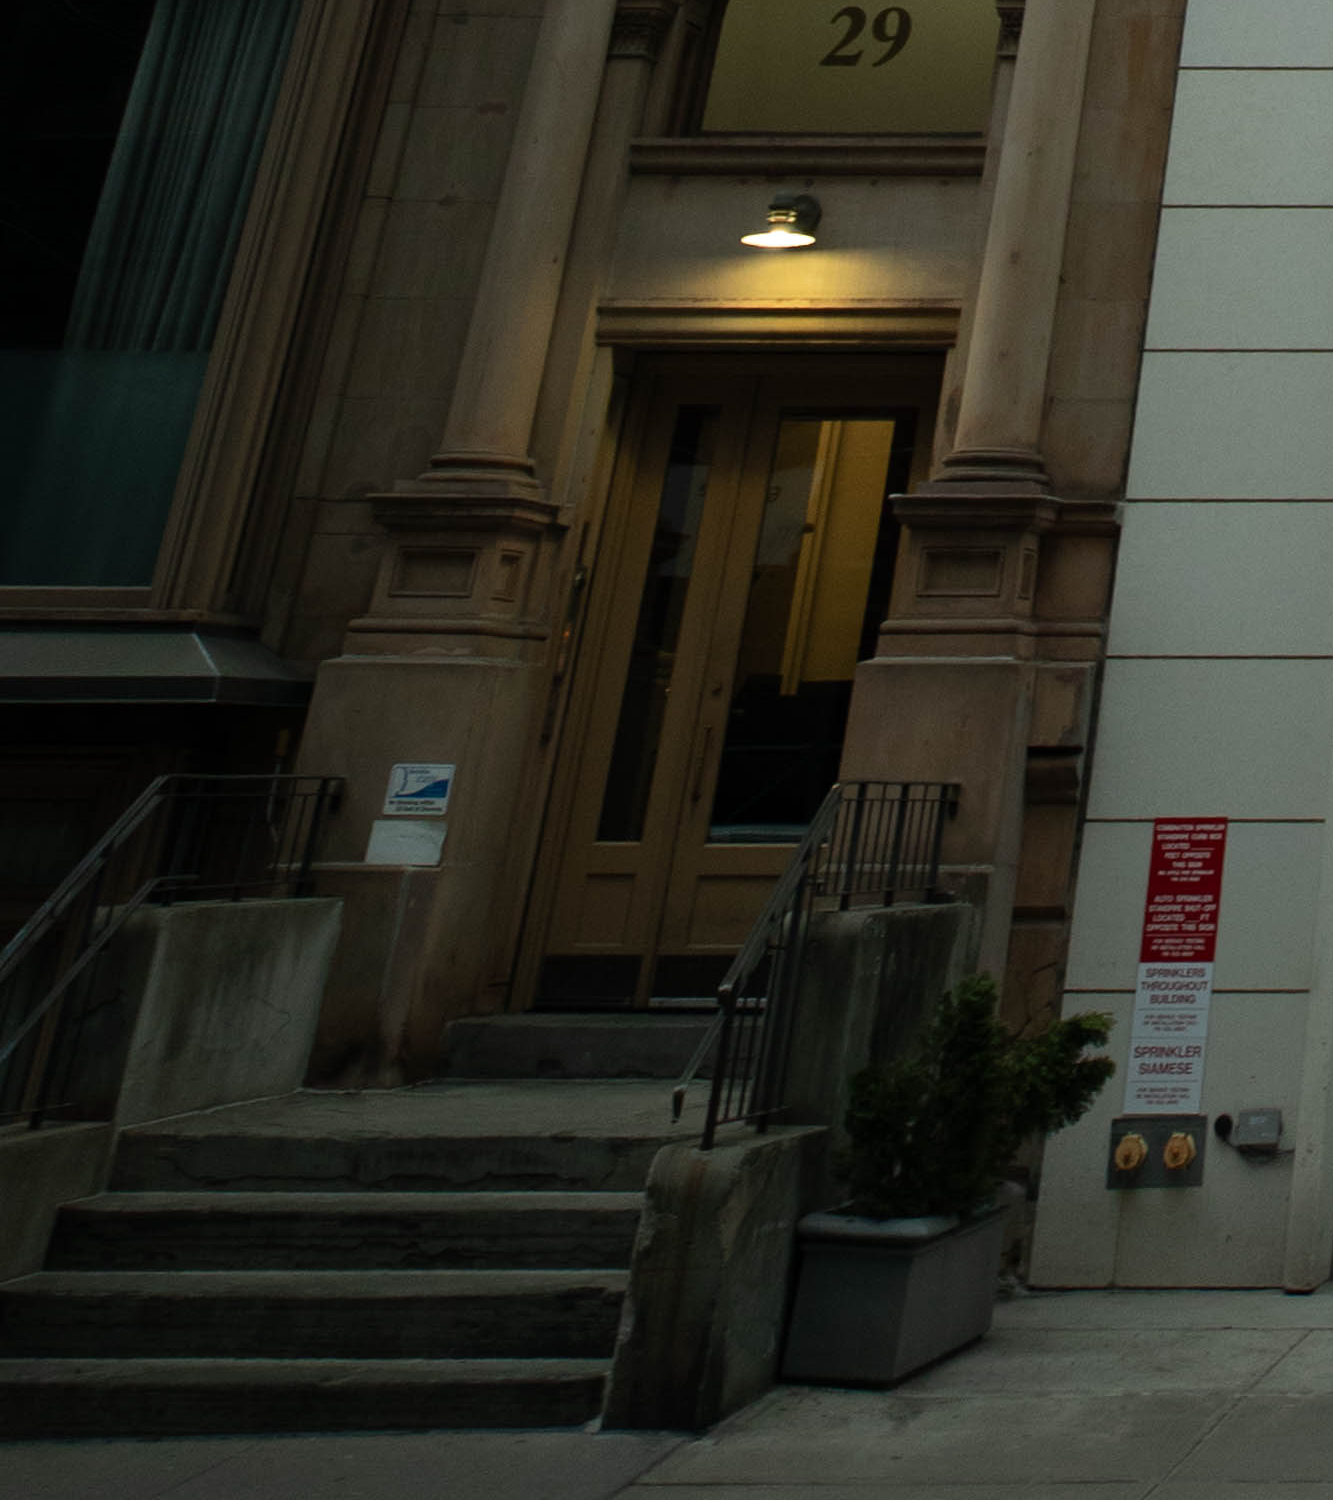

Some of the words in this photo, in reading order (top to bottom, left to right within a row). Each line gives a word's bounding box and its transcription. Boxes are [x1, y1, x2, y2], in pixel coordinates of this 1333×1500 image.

[819, 4, 913, 69] 29
[1145, 967, 1206, 978] SPRINKLERS
[1141, 980, 1209, 991] THROUGHOUT
[1150, 994, 1196, 1004] BUILDING
[1134, 1045, 1202, 1058] SPRINKLER
[1138, 1062, 1193, 1075] SIAMESE
